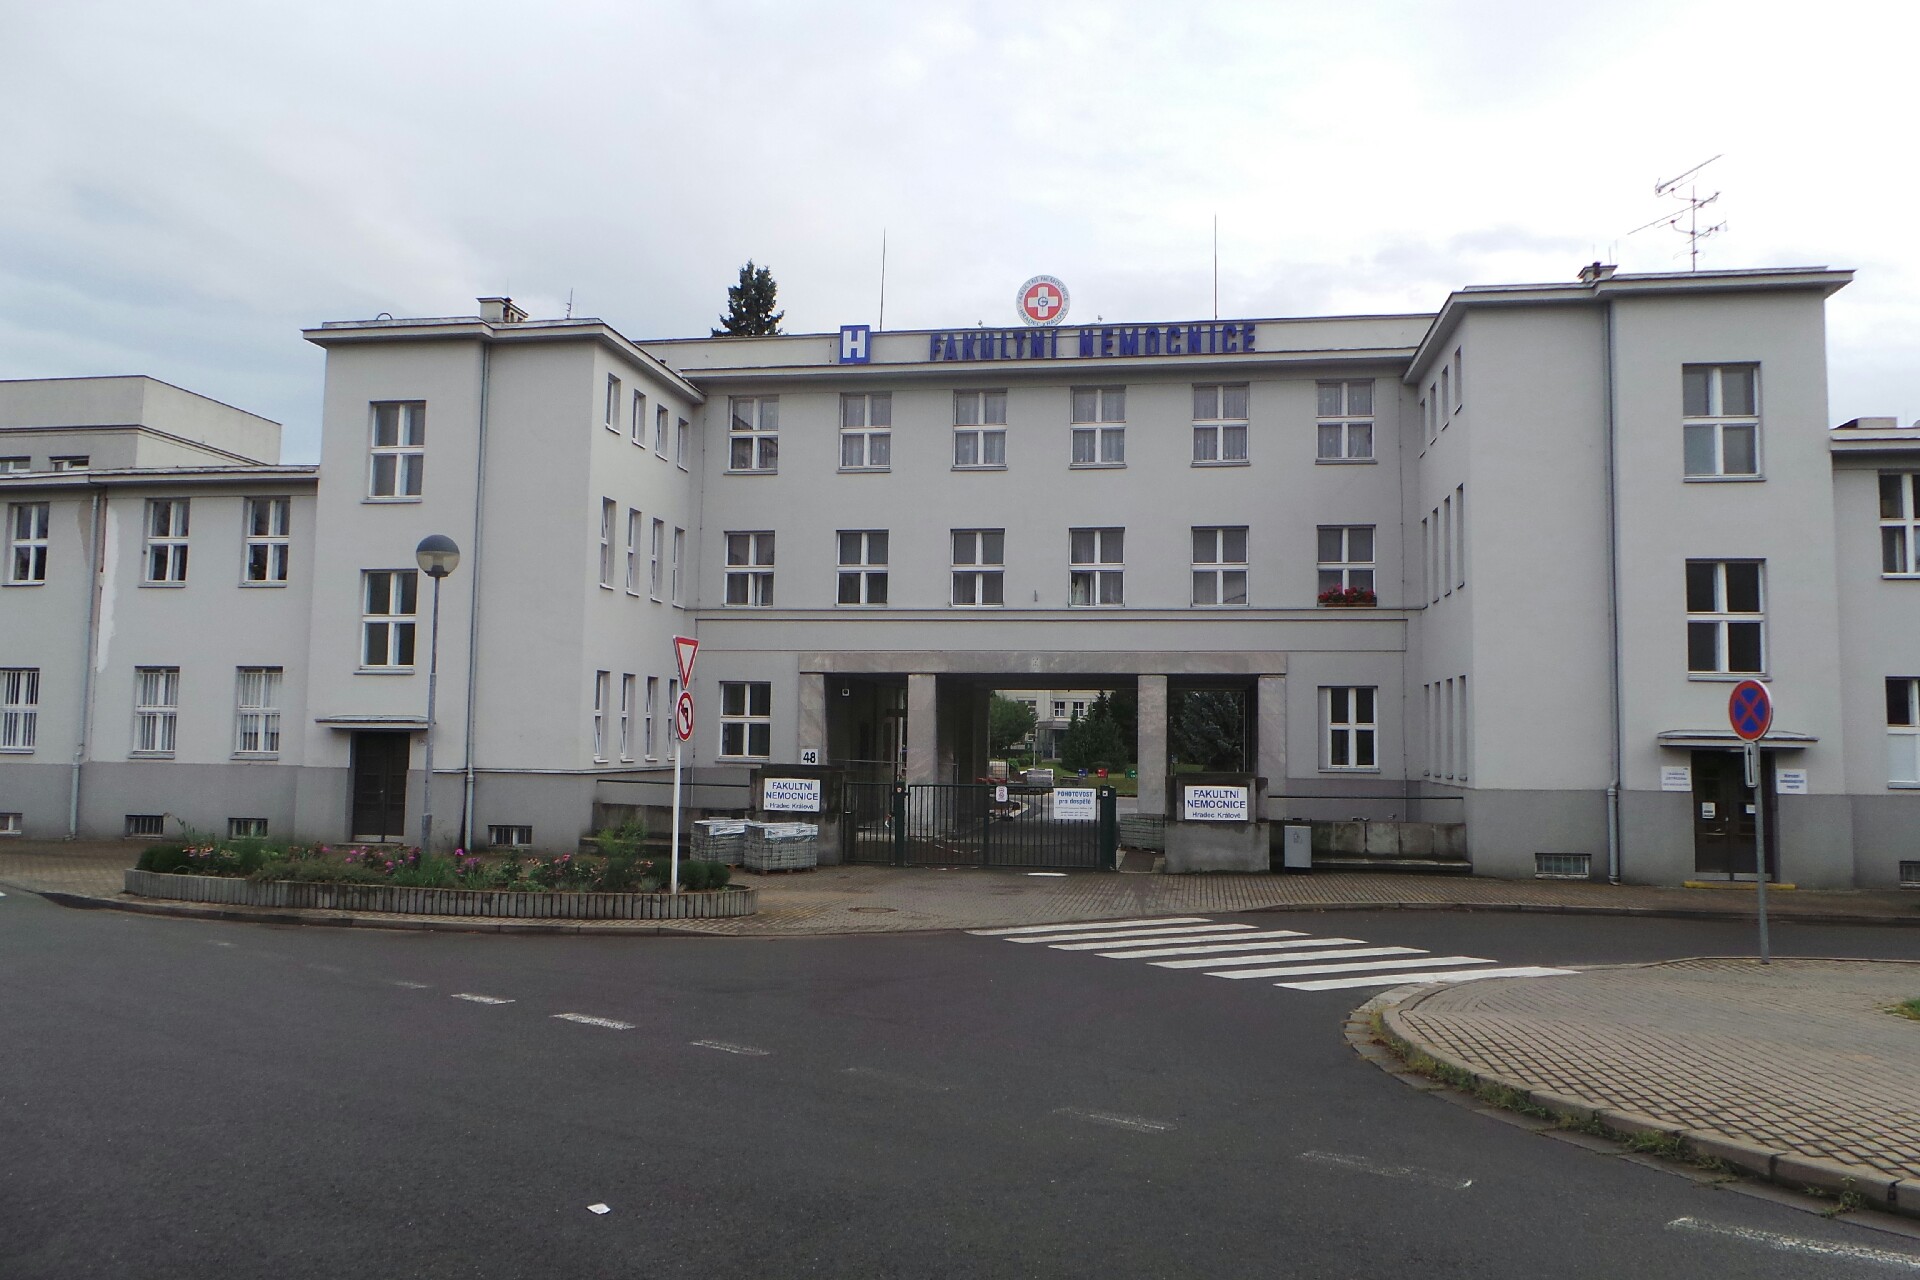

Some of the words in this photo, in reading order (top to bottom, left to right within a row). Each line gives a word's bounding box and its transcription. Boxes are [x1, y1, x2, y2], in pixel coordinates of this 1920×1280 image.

[842, 330, 867, 359] H
[1079, 324, 1256, 357] NEMOCNICE
[803, 752, 816, 763] 48
[772, 781, 813, 790] FAKULTNÍ
[765, 791, 819, 801] NEMOCNICE
[1193, 789, 1239, 799] FAKULTNÍ
[1187, 800, 1246, 809] NEMOCNICE
